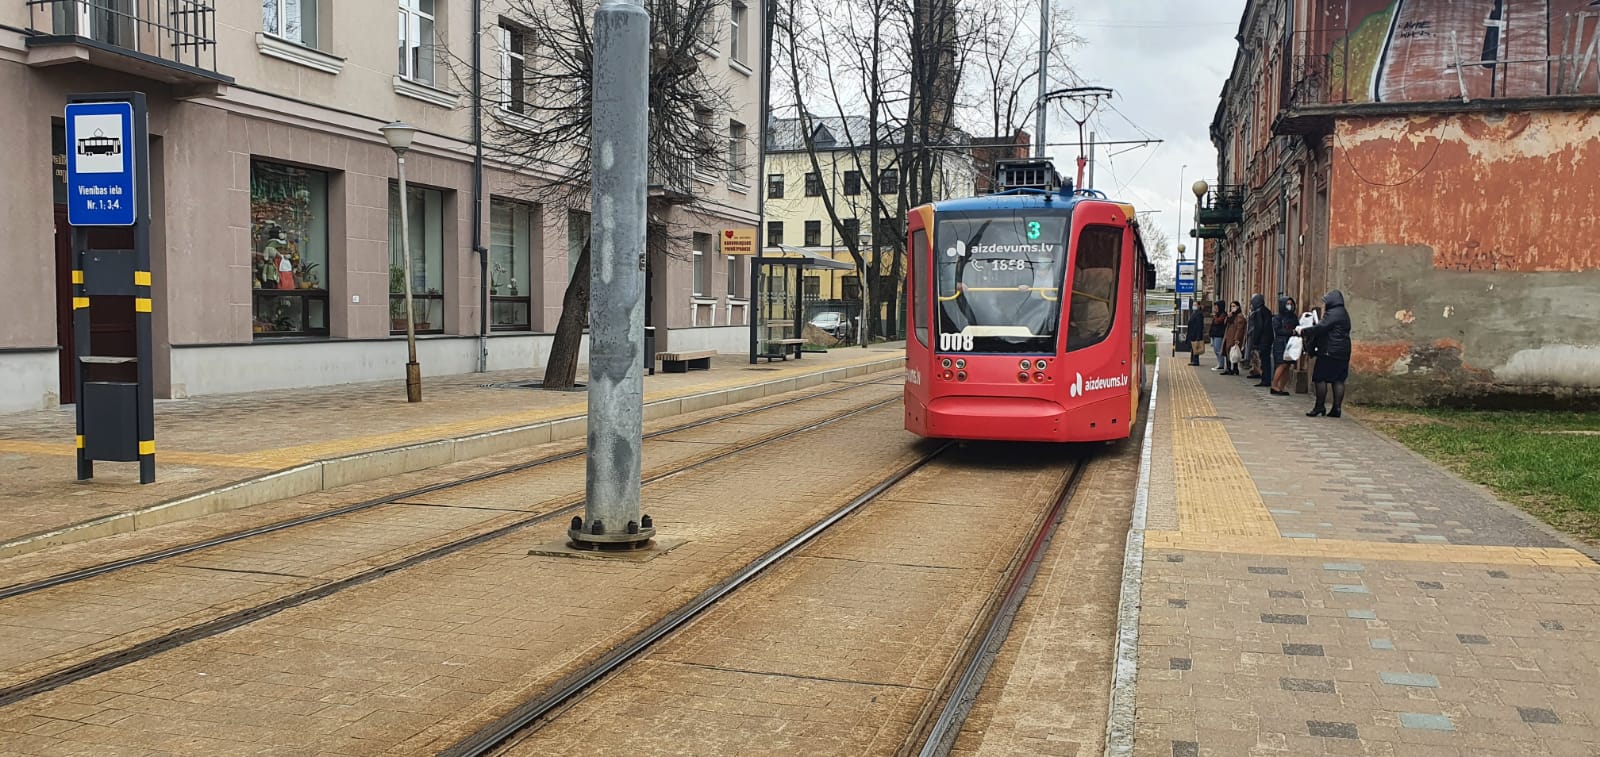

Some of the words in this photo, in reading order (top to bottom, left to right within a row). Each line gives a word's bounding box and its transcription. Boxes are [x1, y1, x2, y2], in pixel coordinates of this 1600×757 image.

[78, 185, 108, 195] Vienības
[109, 185, 122, 195] iela
[87, 200, 98, 210] Nr.
[1027, 221, 1041, 239] 3
[971, 243, 1054, 254] aizdevums.lv
[940, 333, 974, 351] 008
[1085, 373, 1129, 391] aizdevums.lv
